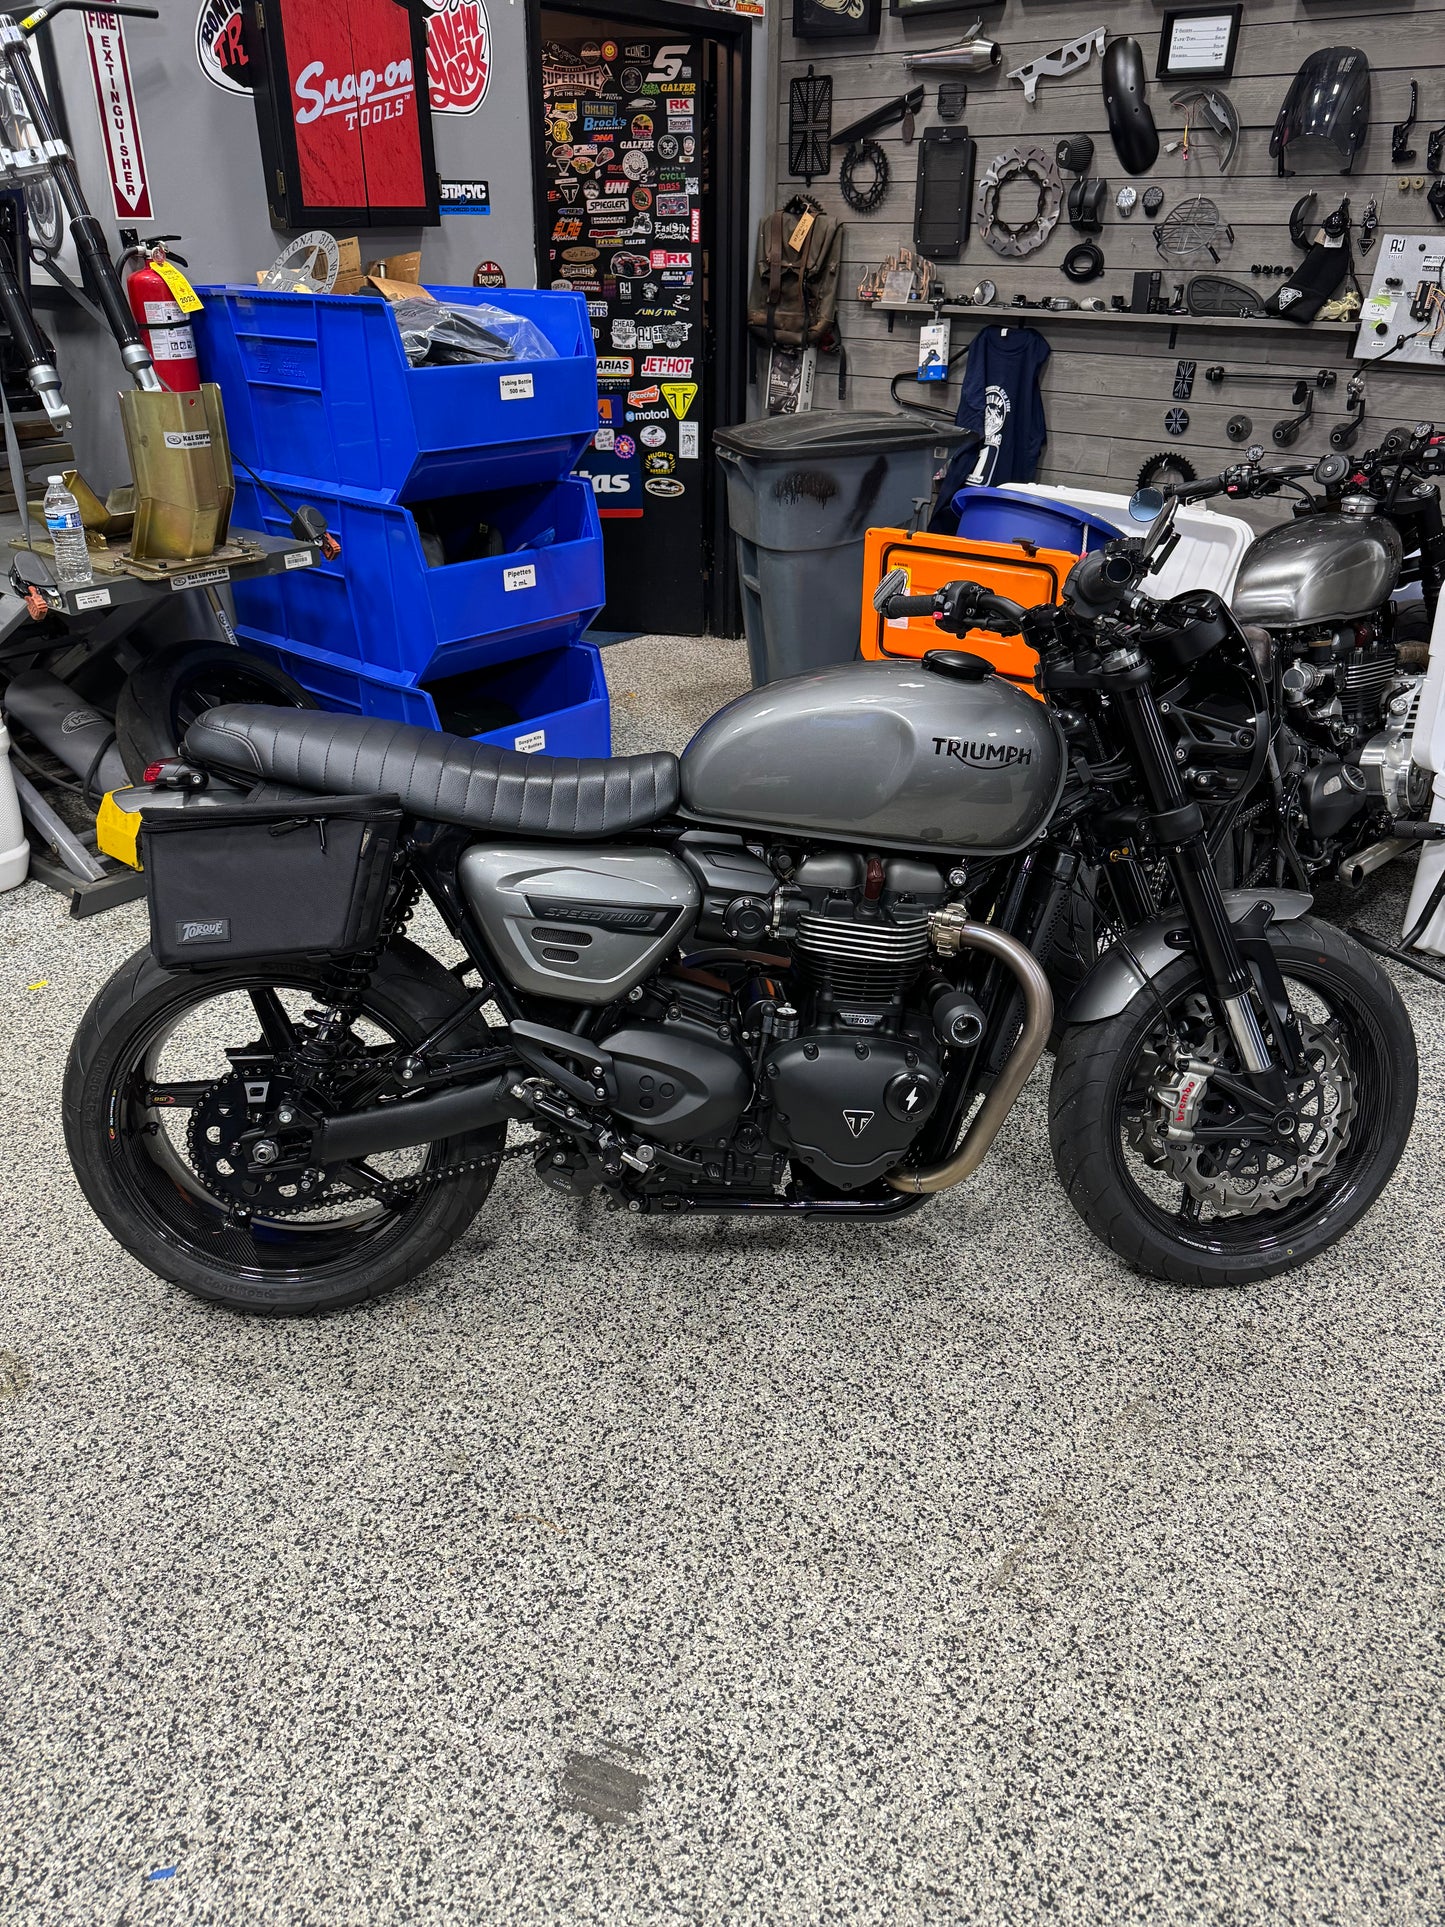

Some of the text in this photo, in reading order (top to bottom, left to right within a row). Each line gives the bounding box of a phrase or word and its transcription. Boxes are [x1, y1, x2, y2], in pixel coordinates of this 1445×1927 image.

[88, 11, 117, 30] FIRE
[428, 3, 480, 62] NEW
[426, 32, 488, 108] YORK
[295, 58, 413, 124] Snap-on
[661, 83, 696, 92] GALFER
[669, 100, 690, 109] RK
[101, 36, 136, 196] EXTINGUISHER
[345, 98, 404, 131] TOOLS
[583, 117, 627, 131] Brock's
[620, 141, 655, 149] GALFER
[441, 184, 487, 199] STACYC
[588, 200, 626, 211] SPIEGLER
[692, 210, 700, 242] MOTUL
[267, 232, 314, 282] DAYTONA
[318, 233, 337, 255] BIKE
[668, 254, 690, 263] RK
[478, 273, 504, 288] TRIUMPH
[597, 361, 629, 369] ARIAS
[643, 358, 692, 373] JET-HOT
[635, 408, 670, 421] motool
[648, 451, 674, 460] HUGH'S
[507, 568, 532, 578] Pipettes
[931, 737, 1032, 770] TRIUMPH
[544, 907, 602, 921] SPEED
[182, 920, 223, 942] TORQUE
[1175, 1082, 1196, 1122] brembo
